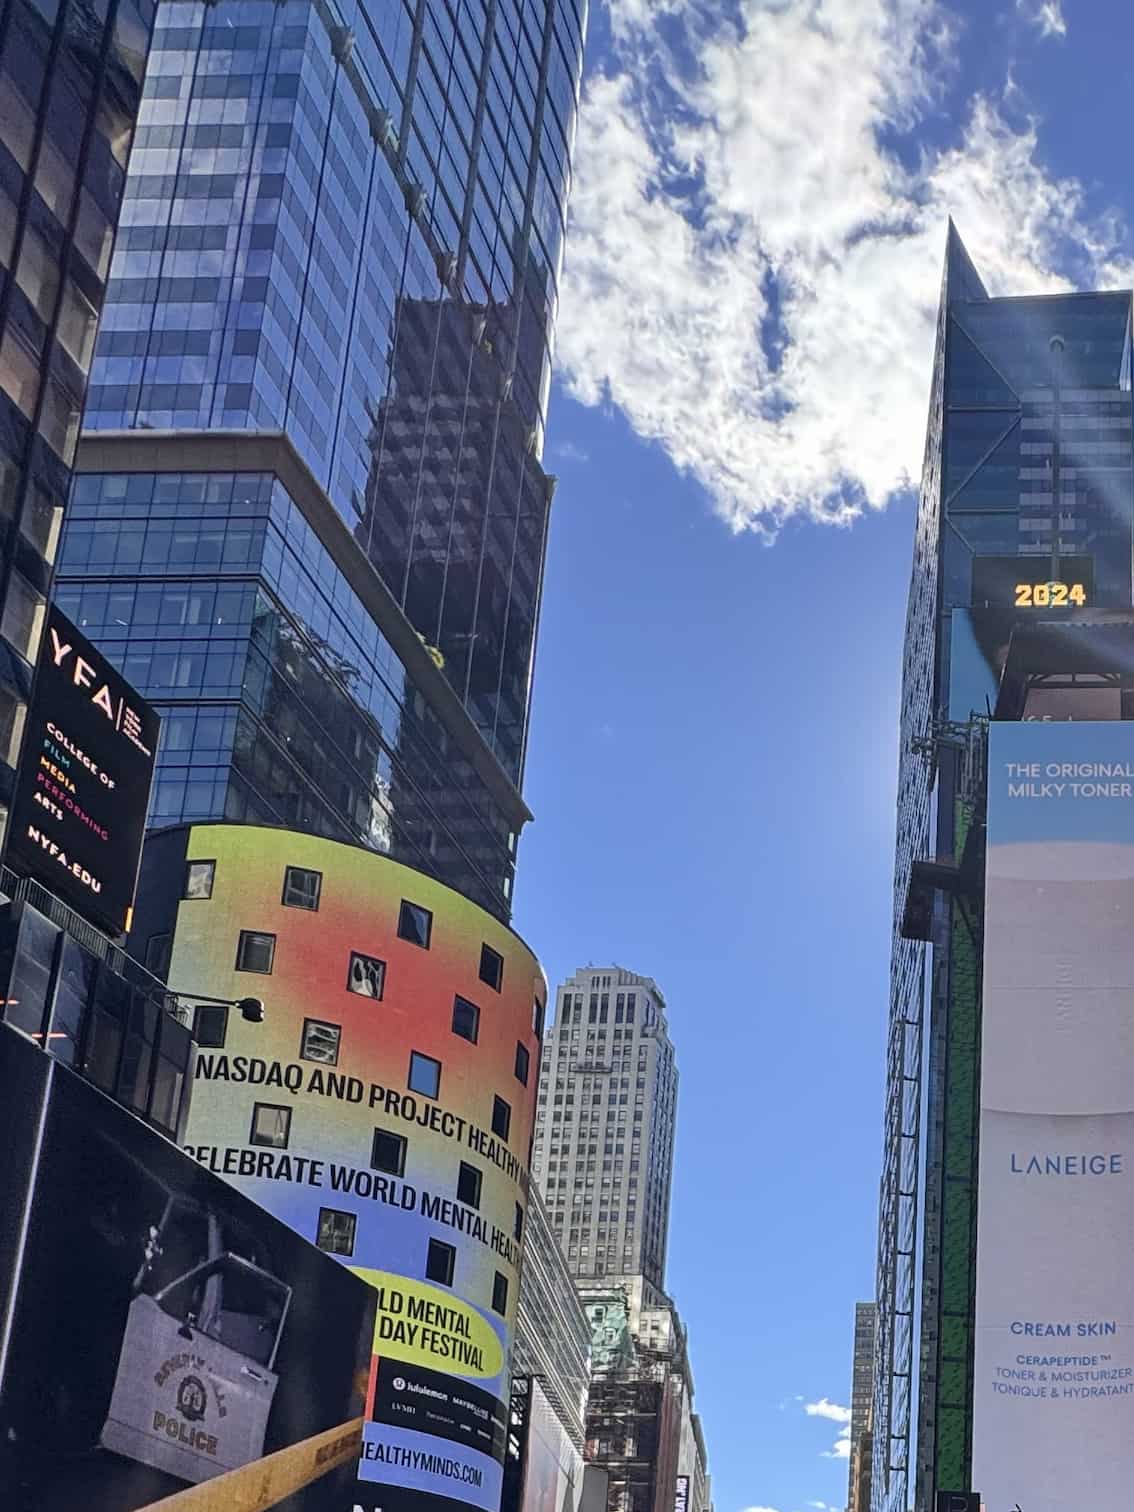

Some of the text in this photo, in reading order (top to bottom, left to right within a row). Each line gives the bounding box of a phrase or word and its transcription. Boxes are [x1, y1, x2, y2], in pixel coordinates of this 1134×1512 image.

[1015, 583, 1086, 606] 2024
[44, 739, 70, 769] FILM
[47, 722, 98, 775] COLLEGE
[100, 772, 116, 789] OF
[1006, 763, 1041, 778] THE
[40, 756, 77, 794] MEDIA
[1008, 783, 1132, 797] MILKY TONER
[34, 792, 63, 820] ARTS
[36, 772, 109, 841] PERFORMING
[28, 825, 101, 893] NYFA.EDU
[195, 1054, 303, 1095] NASDAQ
[307, 1069, 364, 1103] AND
[368, 1083, 466, 1143] PROJECT
[467, 1124, 522, 1183] HEALTHY
[1011, 1153, 1123, 1175] LANEIGE
[329, 1163, 416, 1211] WORLD
[421, 1191, 488, 1244] MENTAL
[407, 1296, 472, 1340] MENTAL
[1010, 1321, 1116, 1336] CREAM SKIN
[379, 1315, 484, 1372] DAY FESTIVAL
[992, 1382, 1046, 1397] TONIQUE
[1050, 1387, 1058, 1398] &
[996, 1367, 1133, 1382] TONER & MOISTURIZER
[153, 1410, 219, 1456] POLICE
